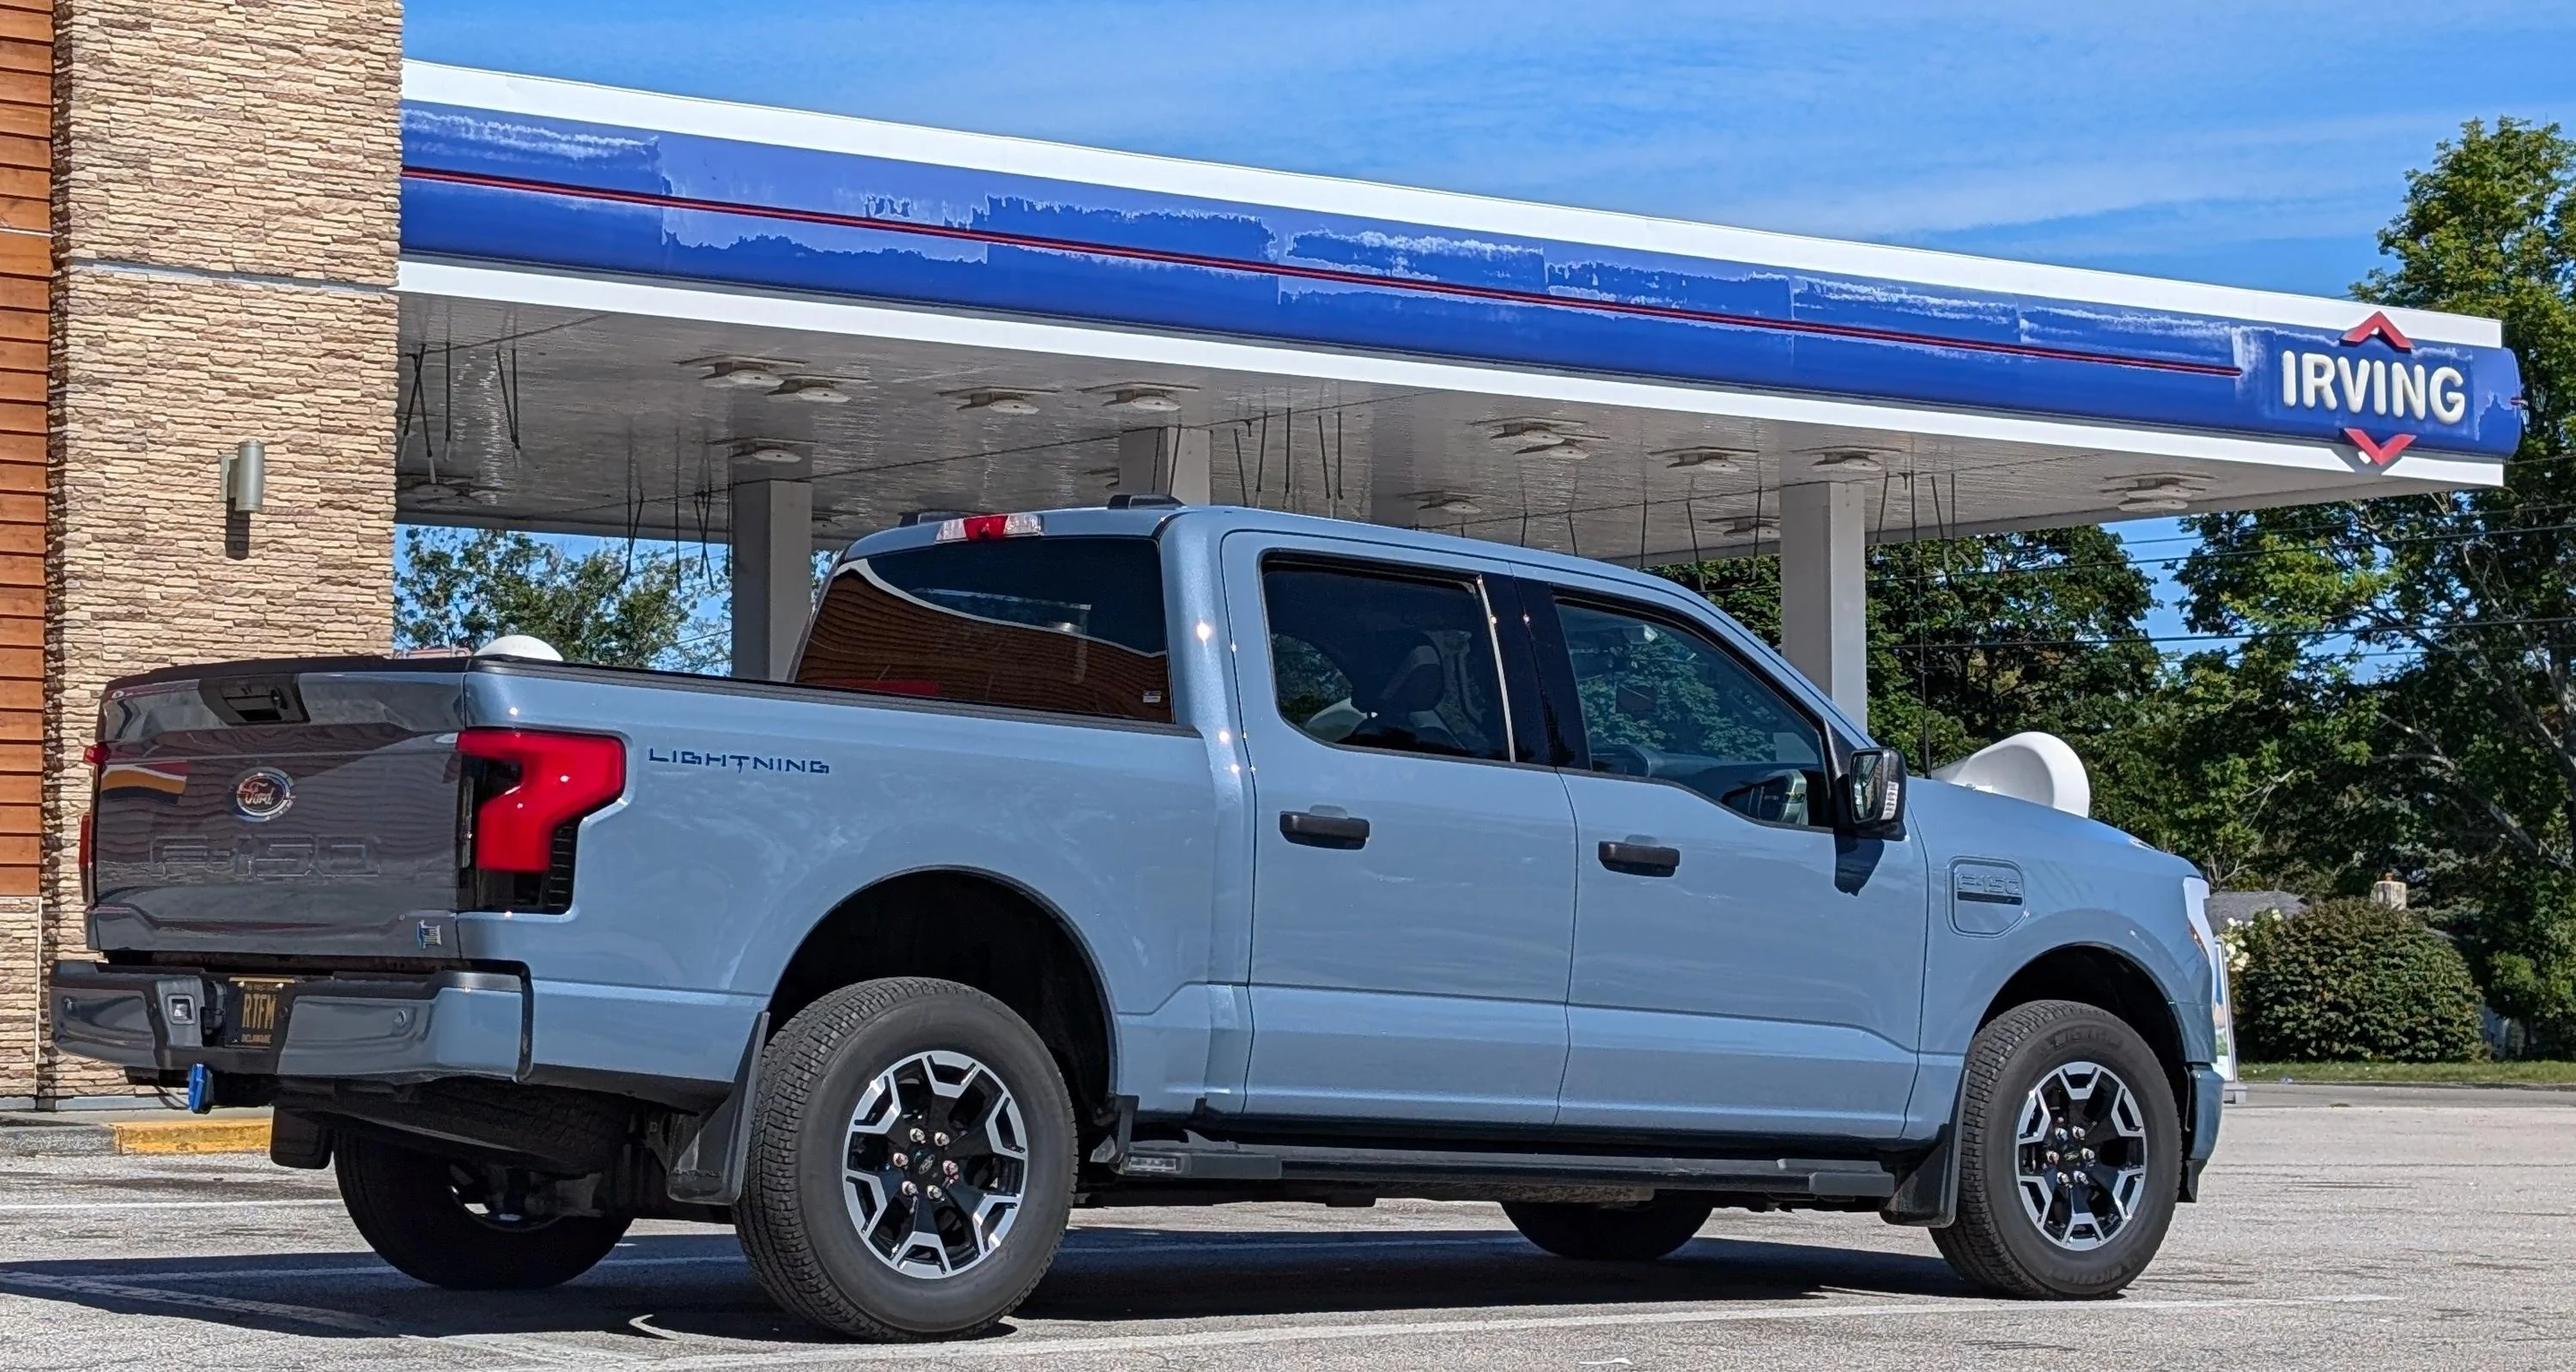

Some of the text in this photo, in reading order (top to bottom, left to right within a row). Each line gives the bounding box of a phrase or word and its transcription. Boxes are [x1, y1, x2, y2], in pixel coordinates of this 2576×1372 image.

[2282, 349, 2465, 424] IRVING
[649, 748, 829, 774] LIGHTNING
[244, 781, 276, 805] Ford
[149, 835, 380, 879] F-150
[241, 993, 276, 1029] RTFM
